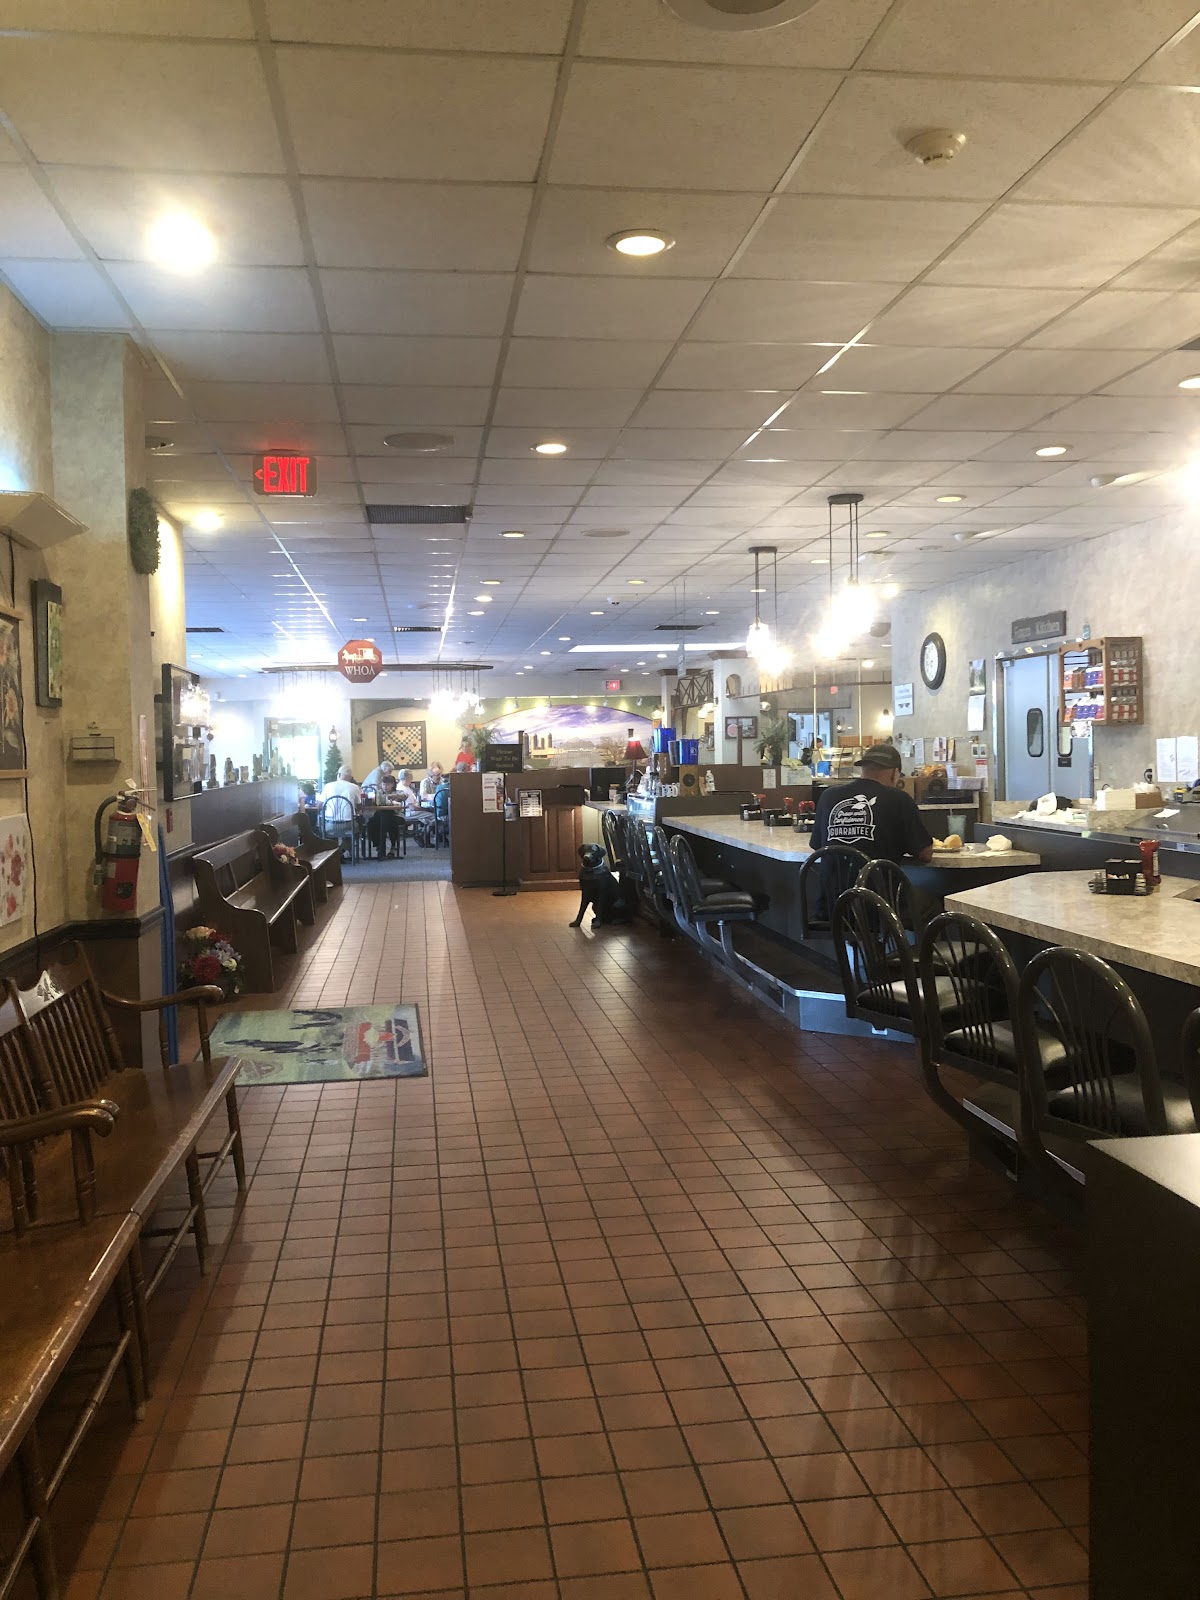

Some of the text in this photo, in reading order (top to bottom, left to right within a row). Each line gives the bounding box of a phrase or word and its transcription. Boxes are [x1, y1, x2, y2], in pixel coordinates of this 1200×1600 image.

[264, 456, 309, 492] EXIT
[344, 665, 376, 675] WHOA
[833, 817, 864, 825] Confidence
[830, 827, 869, 836] GUARANTEE
